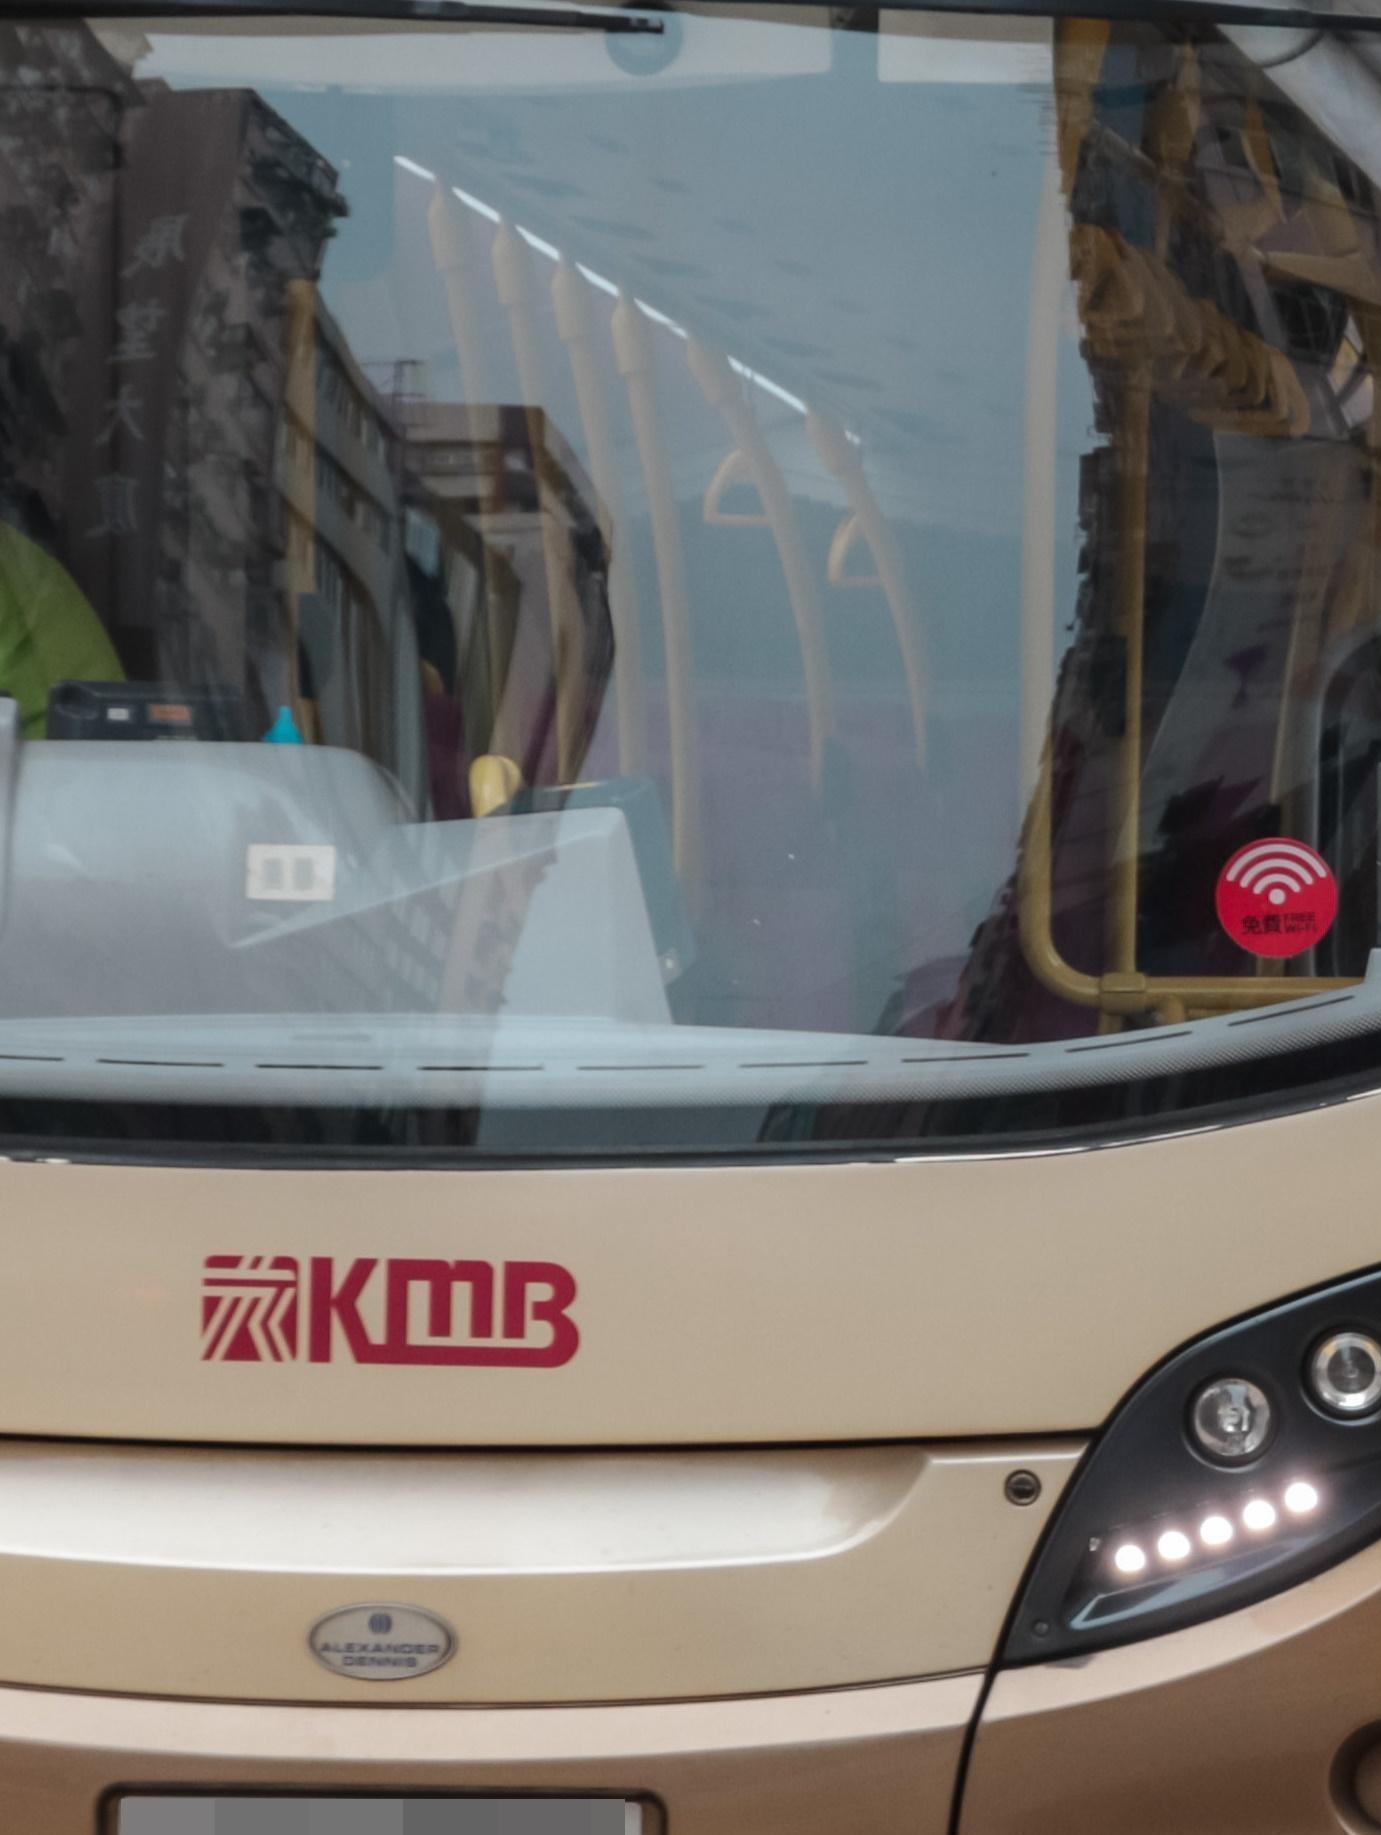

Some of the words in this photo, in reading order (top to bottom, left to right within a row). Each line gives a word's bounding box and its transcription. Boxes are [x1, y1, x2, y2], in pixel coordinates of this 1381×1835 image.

[1241, 913, 1281, 935] 免費
[308, 1256, 580, 1368] KMB
[320, 1642, 440, 1654] ALEXANDER
[342, 1655, 418, 1668] DENNIS
